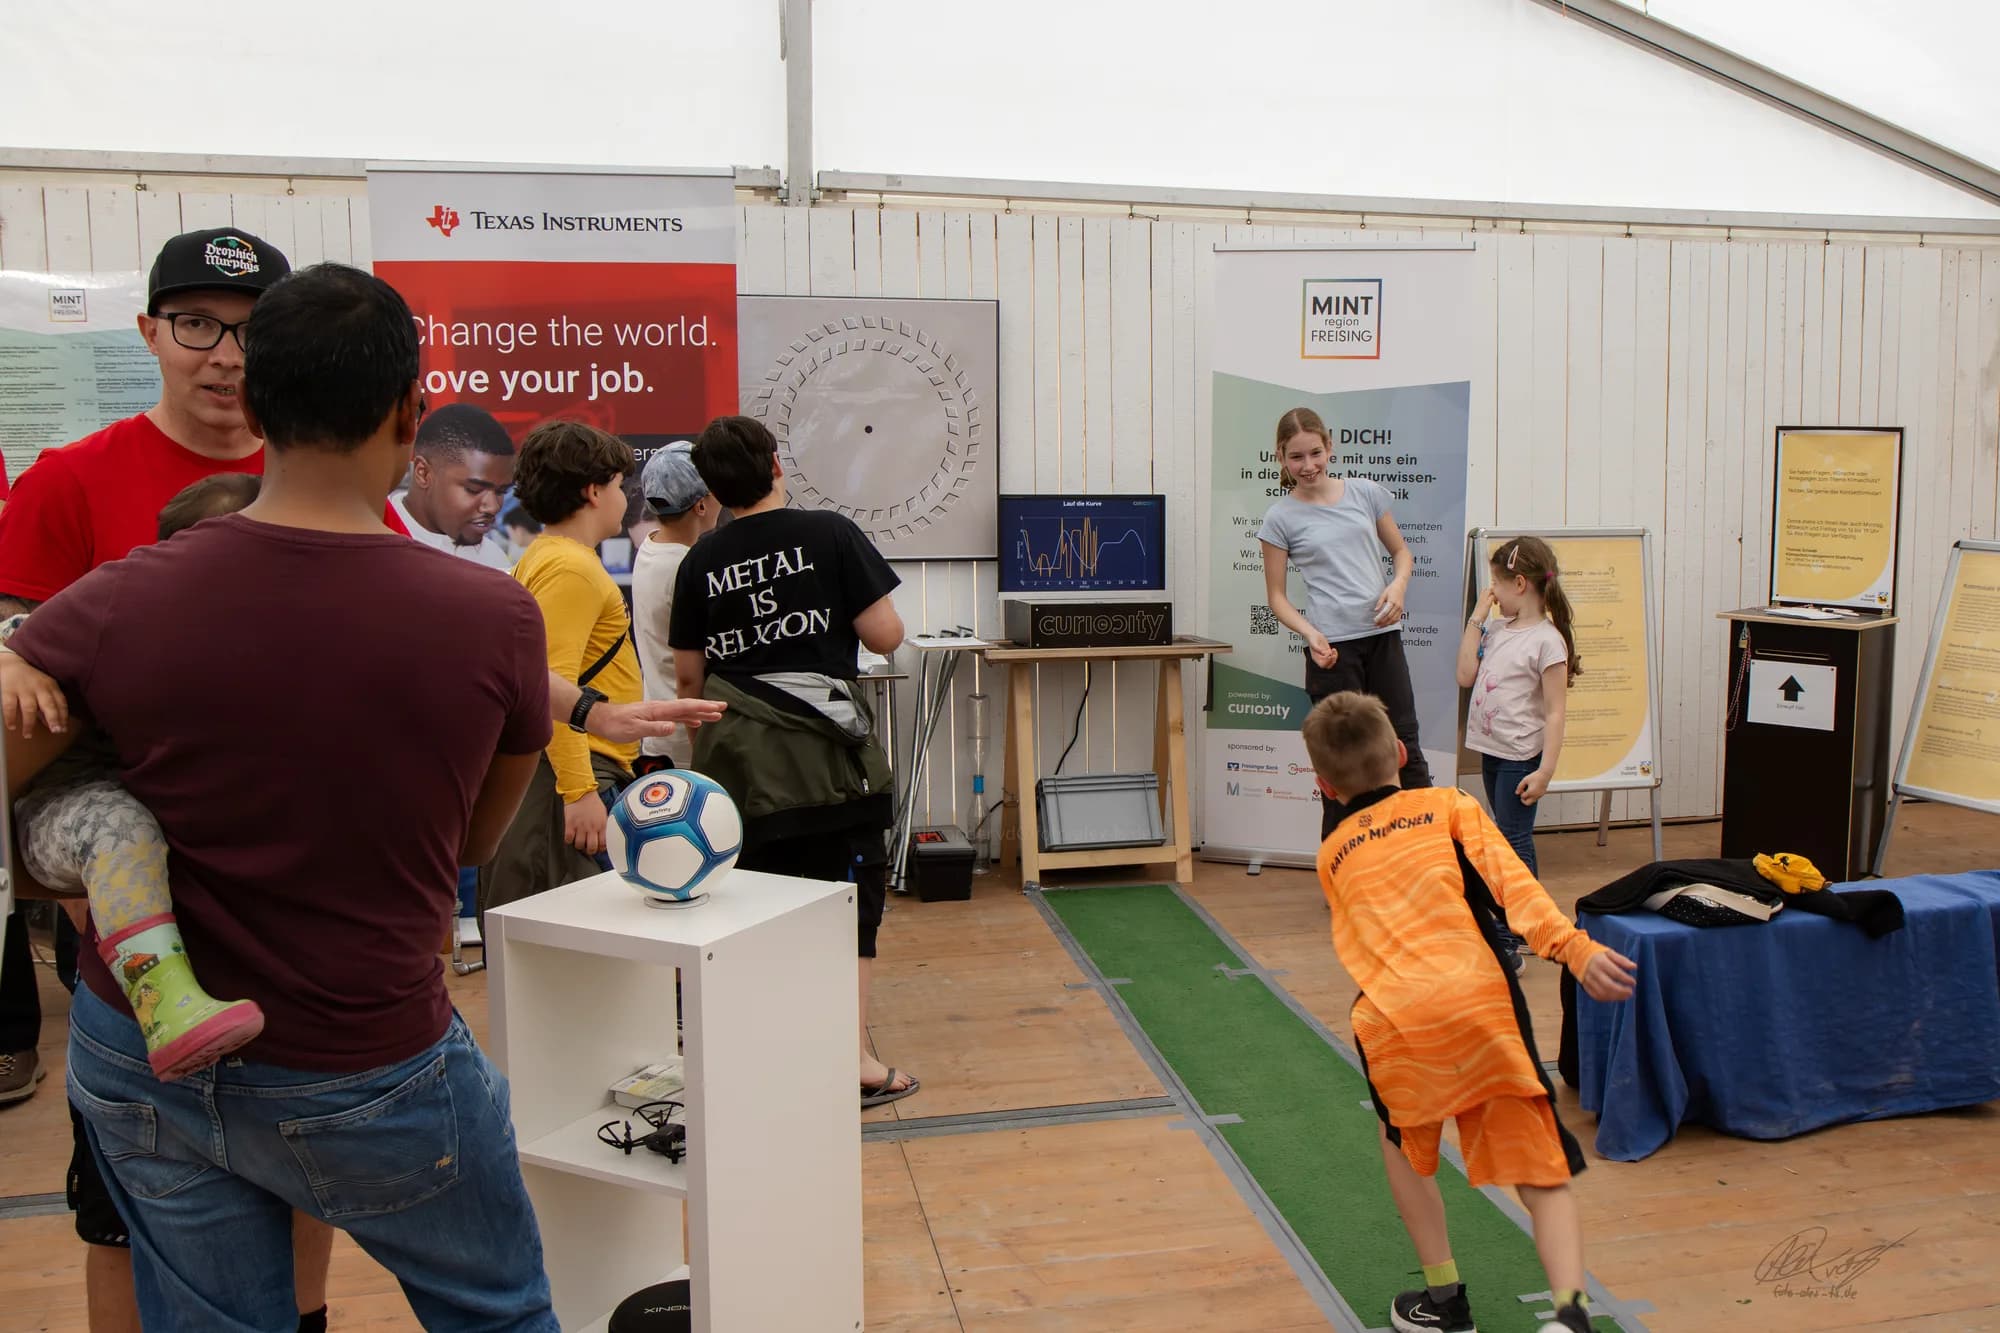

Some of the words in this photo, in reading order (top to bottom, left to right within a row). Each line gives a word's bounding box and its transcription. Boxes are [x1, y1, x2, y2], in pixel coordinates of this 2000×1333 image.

[53, 295, 81, 305] MINT
[1312, 296, 1373, 315] MINT
[1325, 317, 1359, 328] region
[547, 315, 603, 346] the
[613, 315, 717, 346] world.
[1311, 330, 1373, 342] FREISING
[420, 370, 490, 394] ove
[500, 370, 580, 401] your
[588, 362, 654, 401] job.
[1340, 428, 1392, 445] DICH!
[1343, 453, 1363, 464] mit
[1368, 455, 1391, 465] uns
[1396, 454, 1417, 466] ein
[1241, 468, 1253, 479] in
[1257, 468, 1280, 480] die
[1347, 469, 1437, 483] Naturwissen-
[1232, 517, 1248, 526] Wir
[1250, 517, 1264, 526] sin
[1396, 521, 1442, 531] vernetzen
[1403, 535, 1428, 544] reich.
[1240, 549, 1256, 558] Wir
[1420, 555, 1432, 564] für
[706, 546, 815, 598] METAL
[1232, 562, 1264, 573] Kinder,
[748, 586, 778, 618] IS
[1408, 623, 1439, 634] werde
[1227, 743, 1264, 752] sponsored
[1330, 833, 1366, 875] BAYERN
